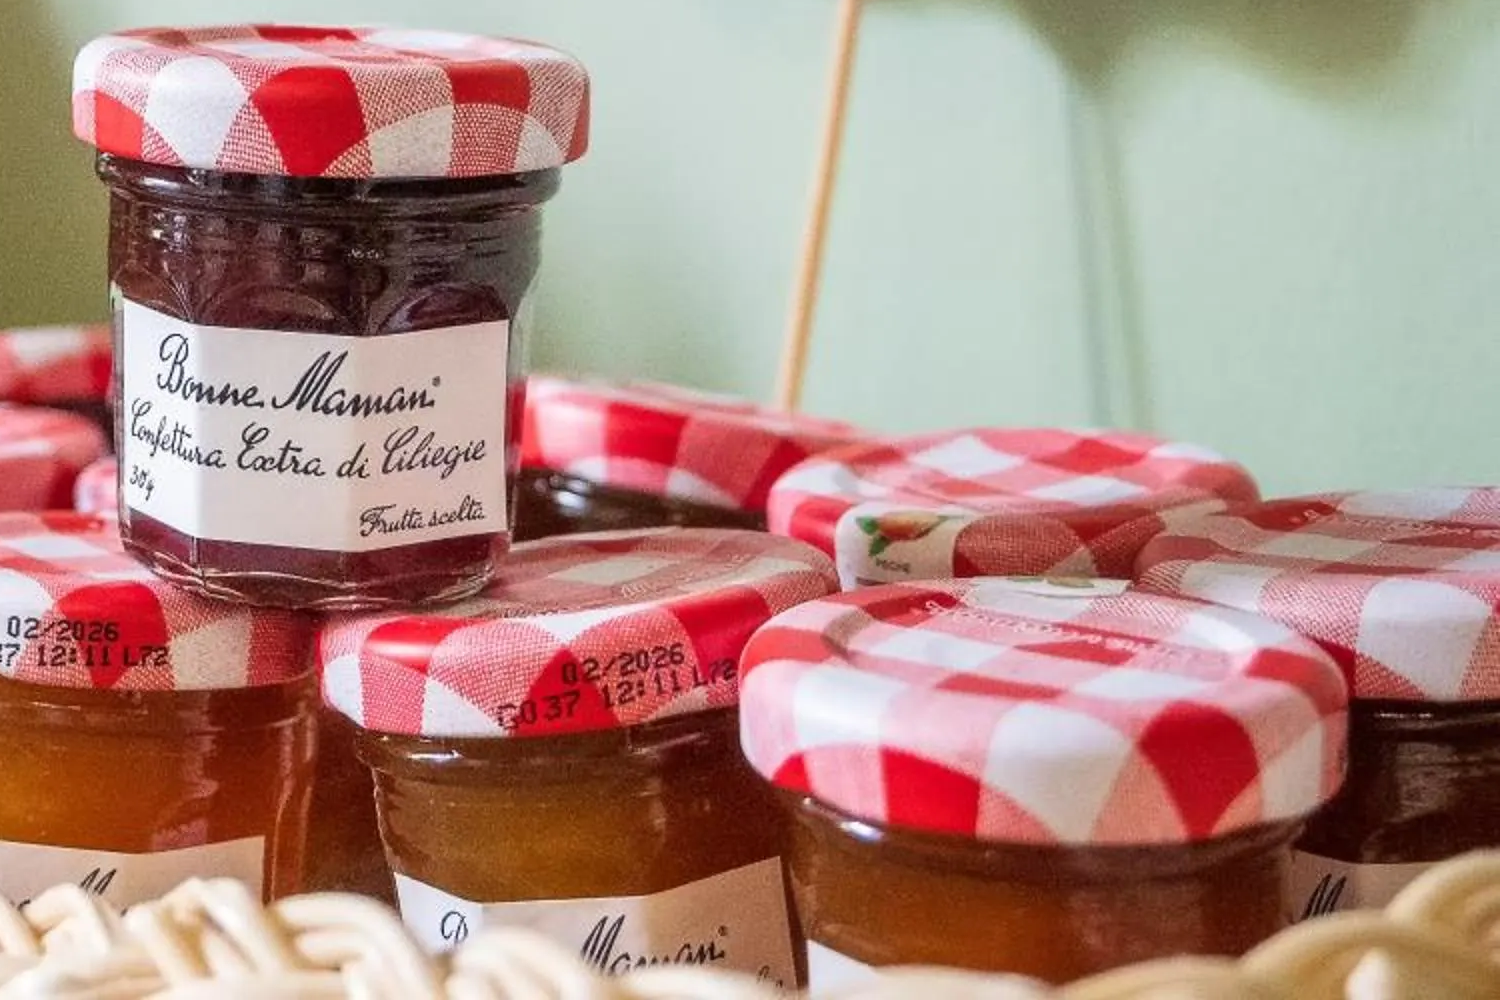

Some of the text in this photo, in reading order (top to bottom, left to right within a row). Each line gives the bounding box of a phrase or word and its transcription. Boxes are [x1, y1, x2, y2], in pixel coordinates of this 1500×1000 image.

[157, 333, 265, 409] Bonne
[131, 397, 487, 480] Confettura Extra di Ciliegie
[359, 494, 487, 537] Frutta scelta
[6, 615, 120, 643] 02/2026
[561, 643, 686, 686] 02/2026
